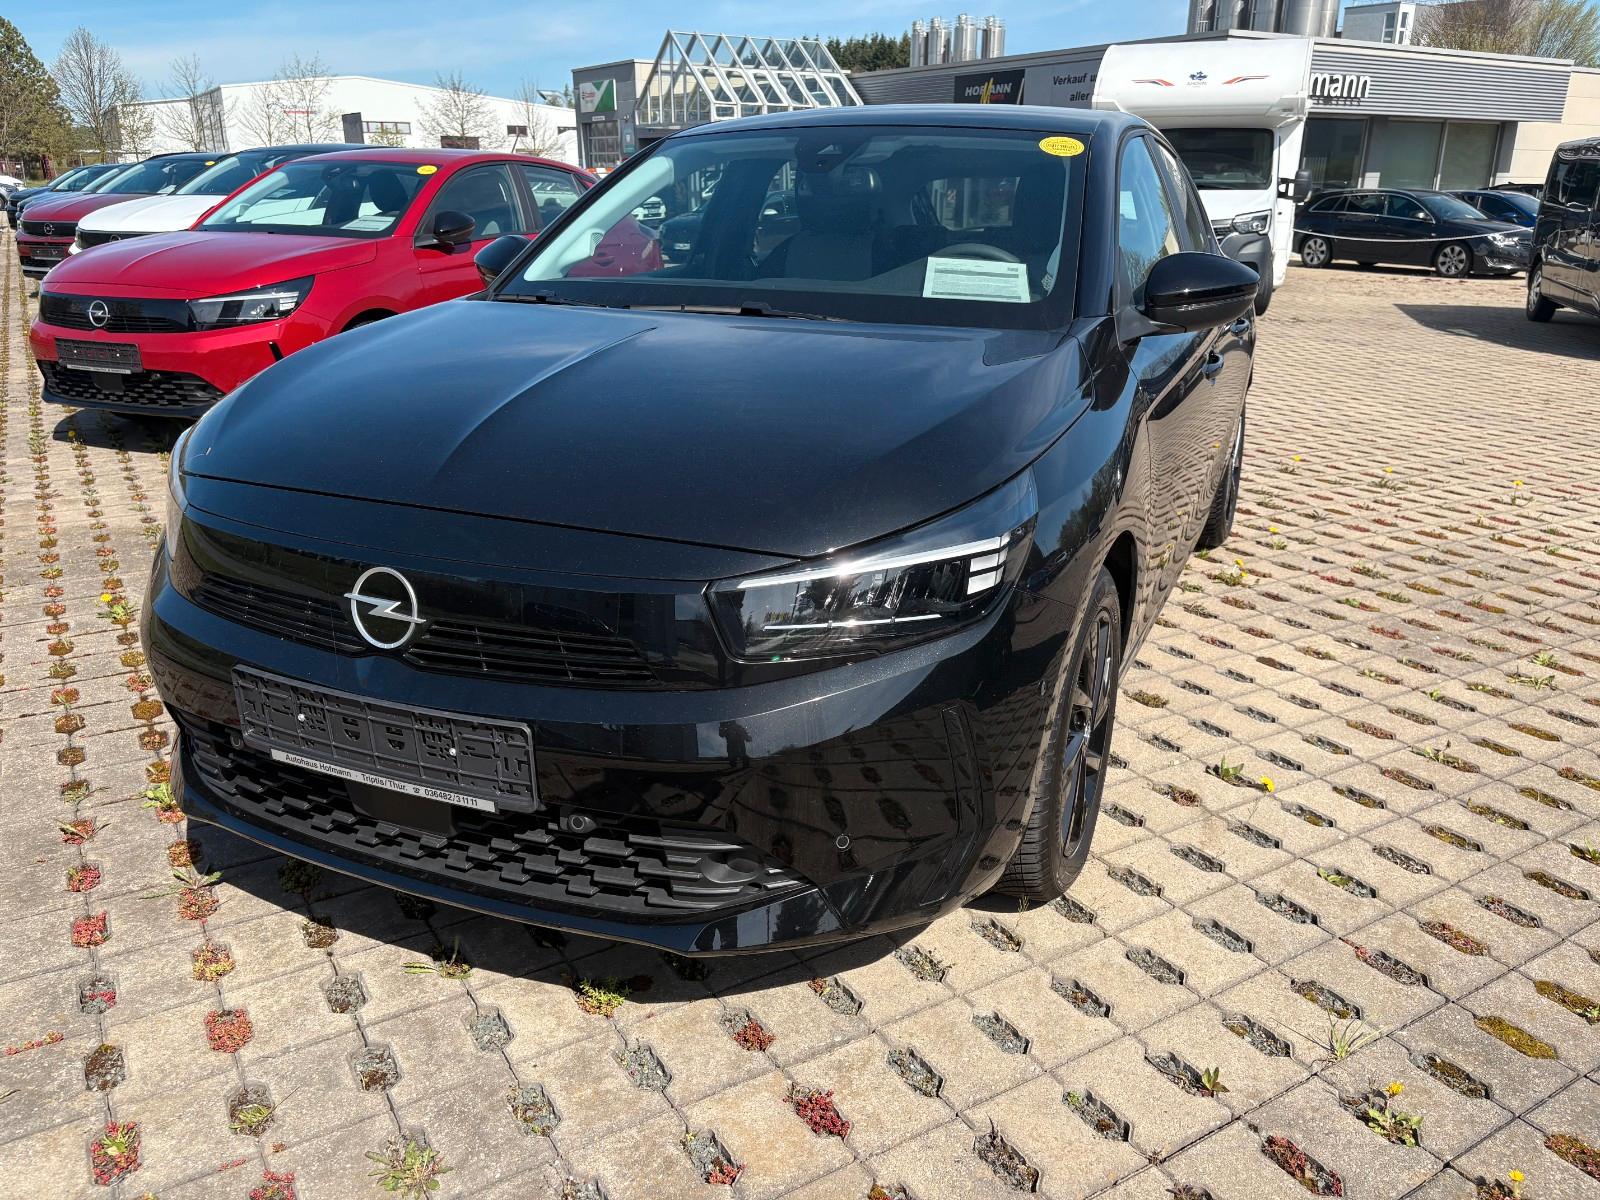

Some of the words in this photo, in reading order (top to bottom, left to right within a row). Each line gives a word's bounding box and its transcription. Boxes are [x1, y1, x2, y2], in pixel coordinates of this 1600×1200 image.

[1053, 72, 1088, 86] Verkauf
[1310, 73, 1371, 98] mann
[1069, 90, 1091, 102] aller
[285, 753, 318, 769] Autohaus
[319, 763, 352, 778] Hofmann
